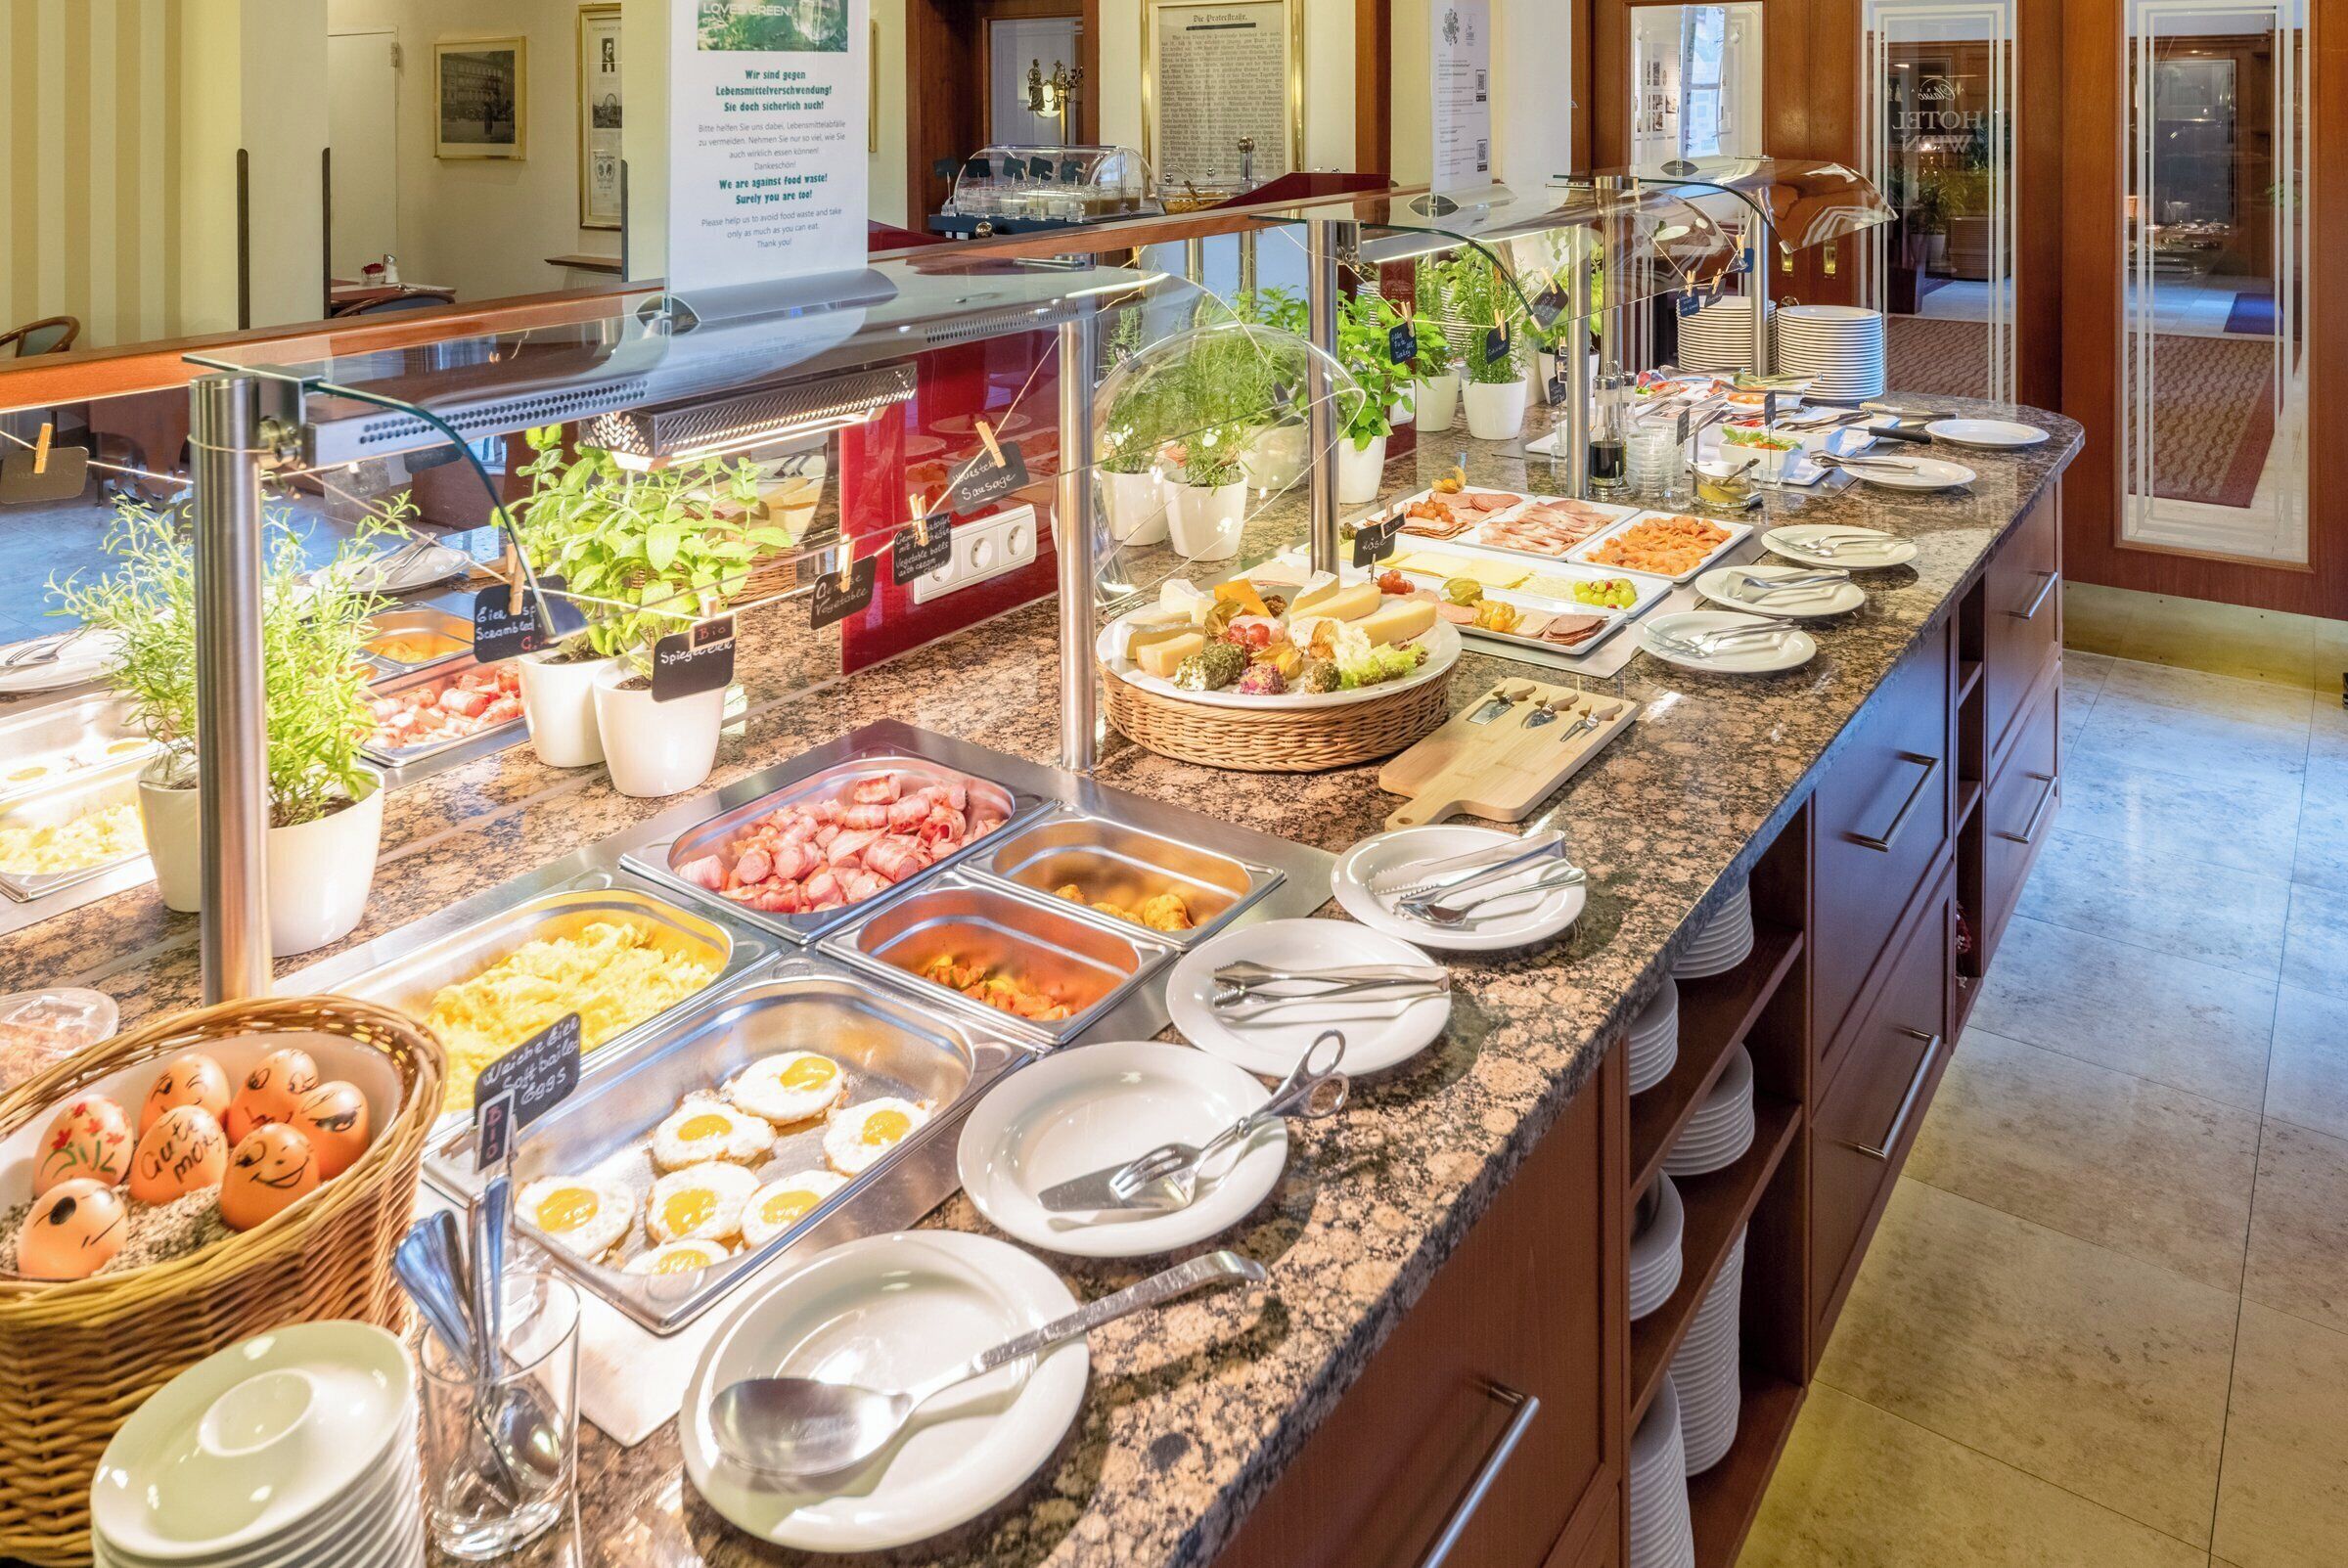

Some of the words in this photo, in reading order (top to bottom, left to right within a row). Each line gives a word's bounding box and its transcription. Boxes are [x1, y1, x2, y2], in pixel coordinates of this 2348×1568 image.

[745, 70, 760, 79] Wir
[763, 70, 780, 79] sind
[783, 71, 805, 80] gegen
[716, 85, 832, 96] Lebensmittelverschwendung!
[724, 103, 736, 112] Sie
[741, 102, 759, 112] doch
[763, 101, 800, 111] sicherlich
[804, 101, 824, 110] auch!
[699, 124, 713, 133] Bitte
[716, 123, 737, 132] helfen
[787, 120, 845, 130] Lebensmittelabfälle
[709, 137, 745, 146] vermeiden.
[748, 135, 777, 144] Nehmen
[729, 149, 745, 158] auch
[747, 148, 772, 157] wirklich
[794, 147, 819, 156] können!
[754, 161, 795, 170] Dankeschön!
[719, 180, 732, 190] We
[736, 179, 748, 188] are
[752, 177, 781, 188] against
[785, 175, 800, 185] food
[805, 173, 827, 183] waste!
[737, 194, 761, 204] Surely
[765, 192, 779, 202] you
[783, 192, 794, 201] are
[798, 190, 812, 200] too!
[701, 218, 723, 227] Please
[725, 216, 740, 226] help
[760, 213, 778, 222] avoid
[780, 211, 794, 220] food
[796, 210, 814, 219] waste
[830, 207, 841, 216] take
[728, 229, 742, 238] only
[753, 227, 771, 236] much
[757, 239, 776, 248] Thank
[778, 239, 791, 247] you!
[961, 473, 1016, 500] Sausage
[475, 618, 535, 642] Scrambled
[698, 626, 726, 641] Bio
[483, 1042, 545, 1086] Weiche
[547, 1016, 579, 1047] Eier
[520, 1066, 566, 1105] Eggs
